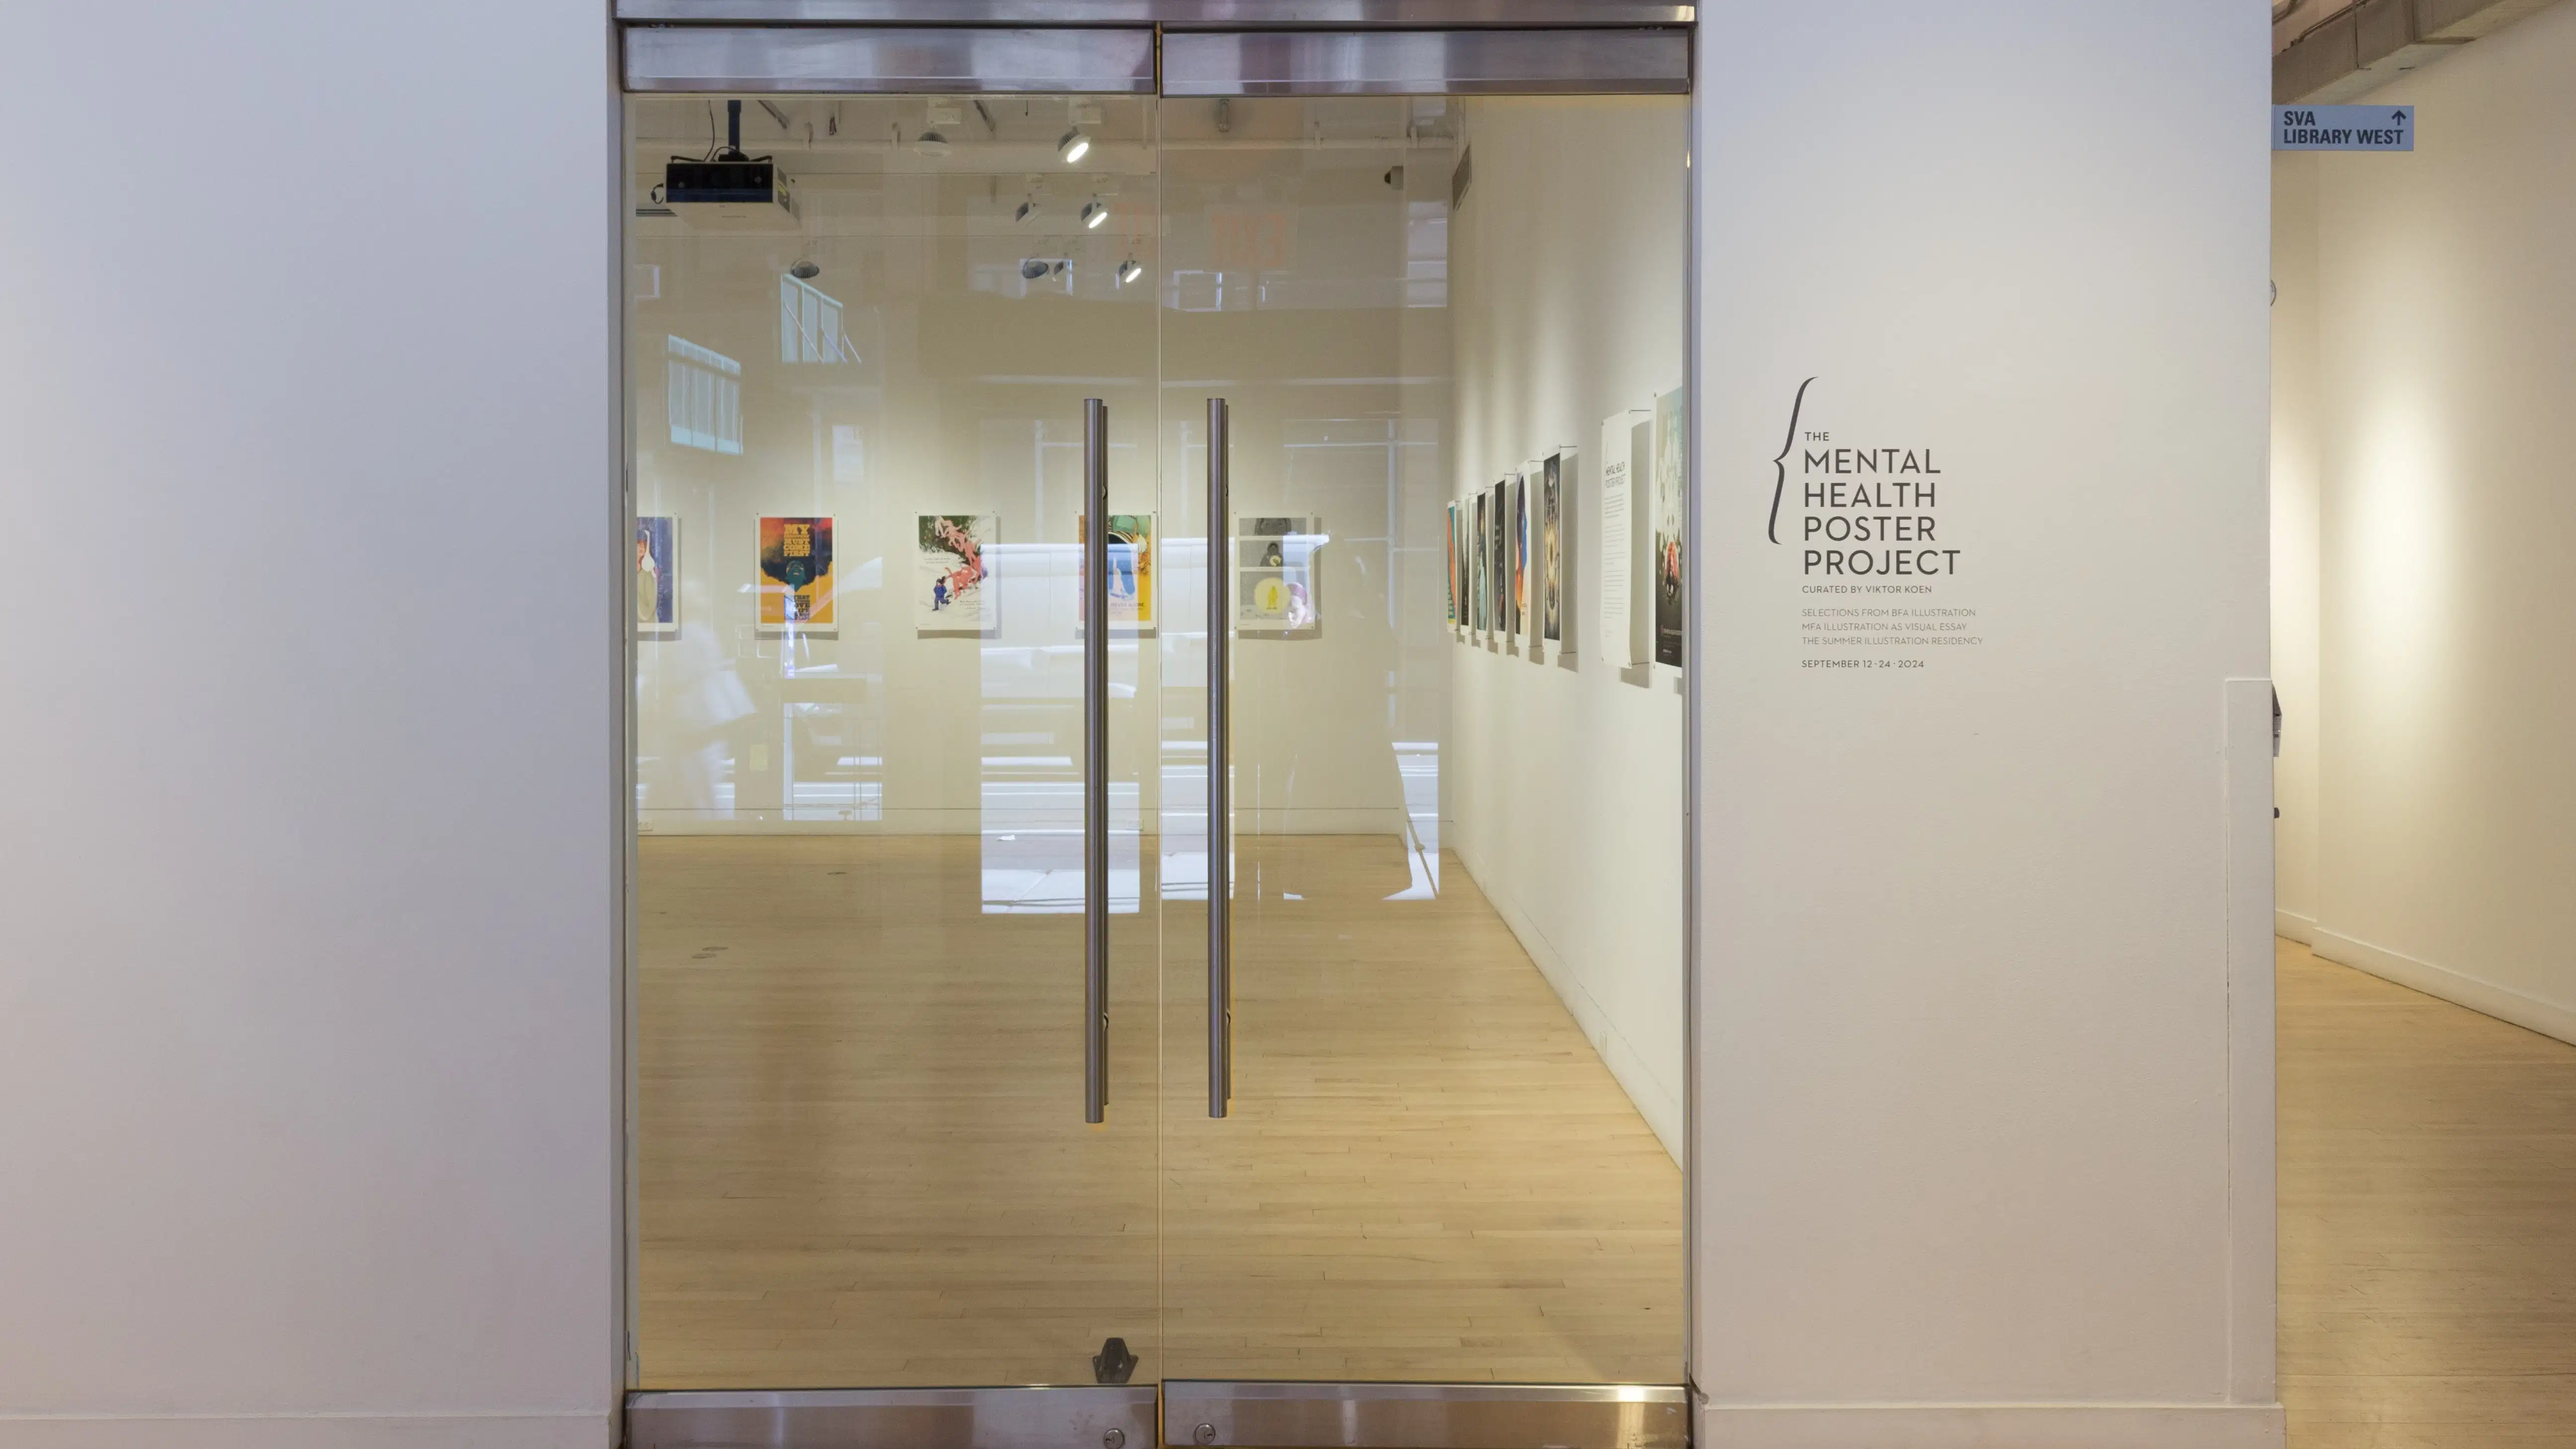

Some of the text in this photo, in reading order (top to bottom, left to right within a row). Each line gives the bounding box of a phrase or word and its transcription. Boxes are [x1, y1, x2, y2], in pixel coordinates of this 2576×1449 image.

[2284, 111, 2316, 126] SVA
[2284, 129, 2404, 145] LIBRARY WEST
[1804, 431, 1830, 441] THE
[1804, 448, 1941, 474] MENTAL
[1804, 482, 1935, 508] HEALTH
[784, 524, 810, 535] MY
[1804, 516, 1936, 541] POSTER
[1804, 549, 1961, 575] PROJECT
[1802, 585, 1848, 594] CURATED
[1802, 608, 1975, 617] SELECTIONS FROM BFA ILLUSTRATION
[1824, 622, 1889, 631] ILLUSTRATION
[1904, 623, 1937, 631] VISUAL
[1802, 660, 1860, 668] SEPTEMBER
[1898, 660, 1924, 668] 2024
